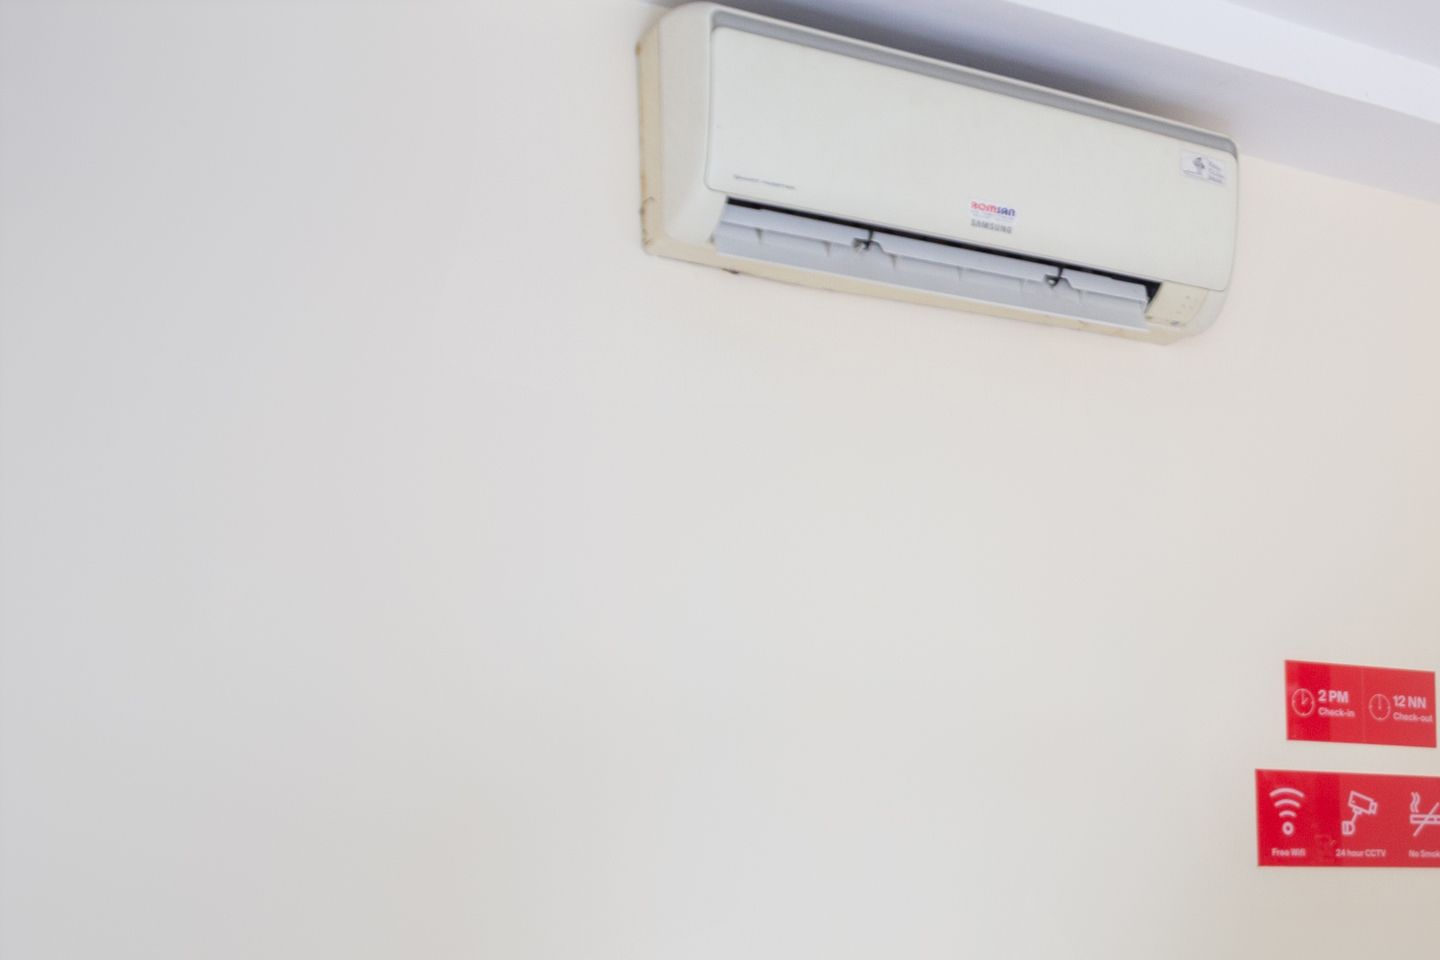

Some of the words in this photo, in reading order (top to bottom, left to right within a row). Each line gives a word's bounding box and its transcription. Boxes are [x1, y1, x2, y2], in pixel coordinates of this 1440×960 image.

[970, 218, 1012, 234] SAMSUNG
[1318, 689, 1327, 702] 2
[1328, 690, 1349, 704] PM
[1392, 695, 1406, 708] 12
[1407, 696, 1427, 709] NN
[1318, 707, 1356, 718] Check-in
[1392, 712, 1433, 723] Check-out
[1271, 848, 1290, 857] Free
[1335, 848, 1345, 857] 24
[1346, 848, 1364, 858] hour
[1364, 848, 1387, 858] CCTV
[1408, 849, 1419, 858] No
